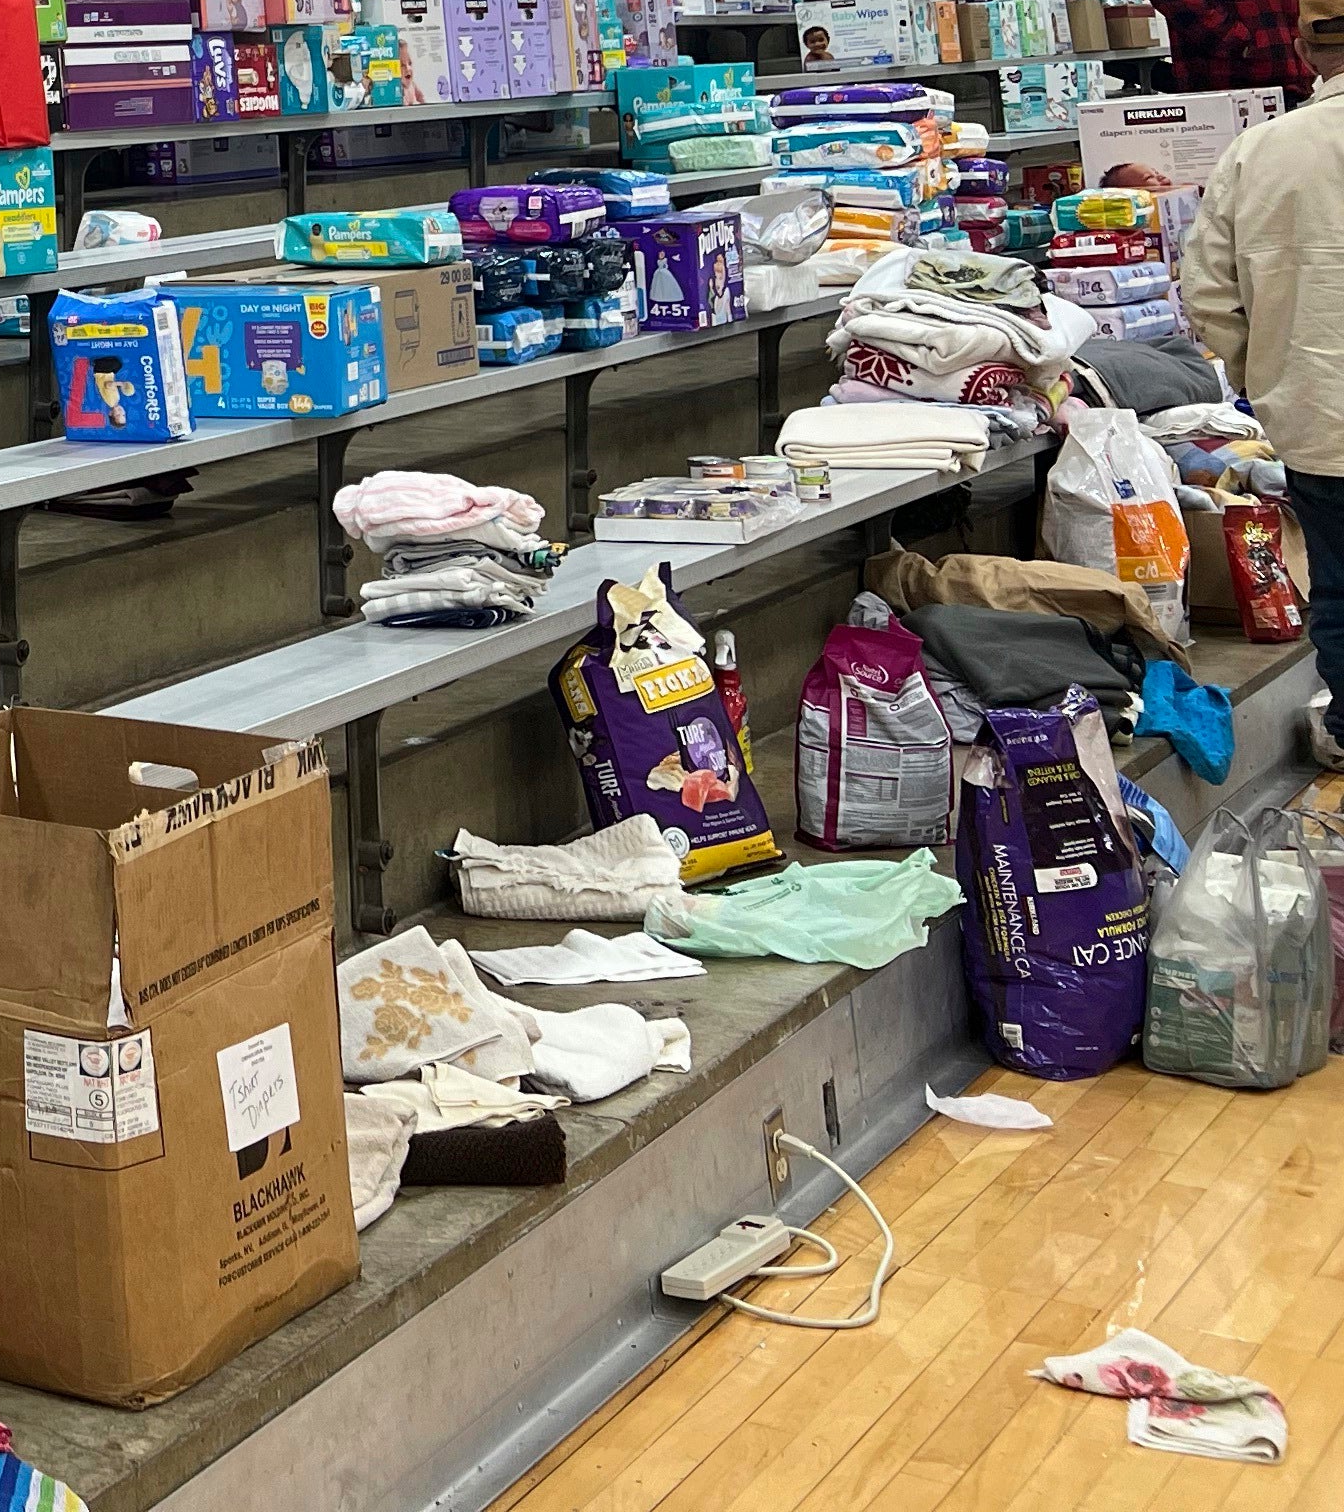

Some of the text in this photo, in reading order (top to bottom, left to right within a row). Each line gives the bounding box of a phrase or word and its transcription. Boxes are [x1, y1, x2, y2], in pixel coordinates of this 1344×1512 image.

[831, 7, 889, 21] Baby Wipes
[240, 96, 279, 112] HUGGIES
[1126, 107, 1185, 121] KIRKLAND
[1099, 123, 1215, 139] diapers couches pañales
[328, 226, 372, 242] Pampers
[241, 303, 260, 314] DAY
[271, 303, 301, 314] NIGHT
[309, 301, 326, 312] BIG
[650, 303, 690, 318] 4T-5T
[291, 396, 312, 410] 144
[677, 723, 705, 745] TURF
[595, 759, 621, 799] TURF
[993, 844, 1031, 979] MAINTENANCE CA
[1072, 945, 1110, 967] CAT
[94, 1094, 104, 1107] 5
[233, 1162, 306, 1223] BLACKHAWK
